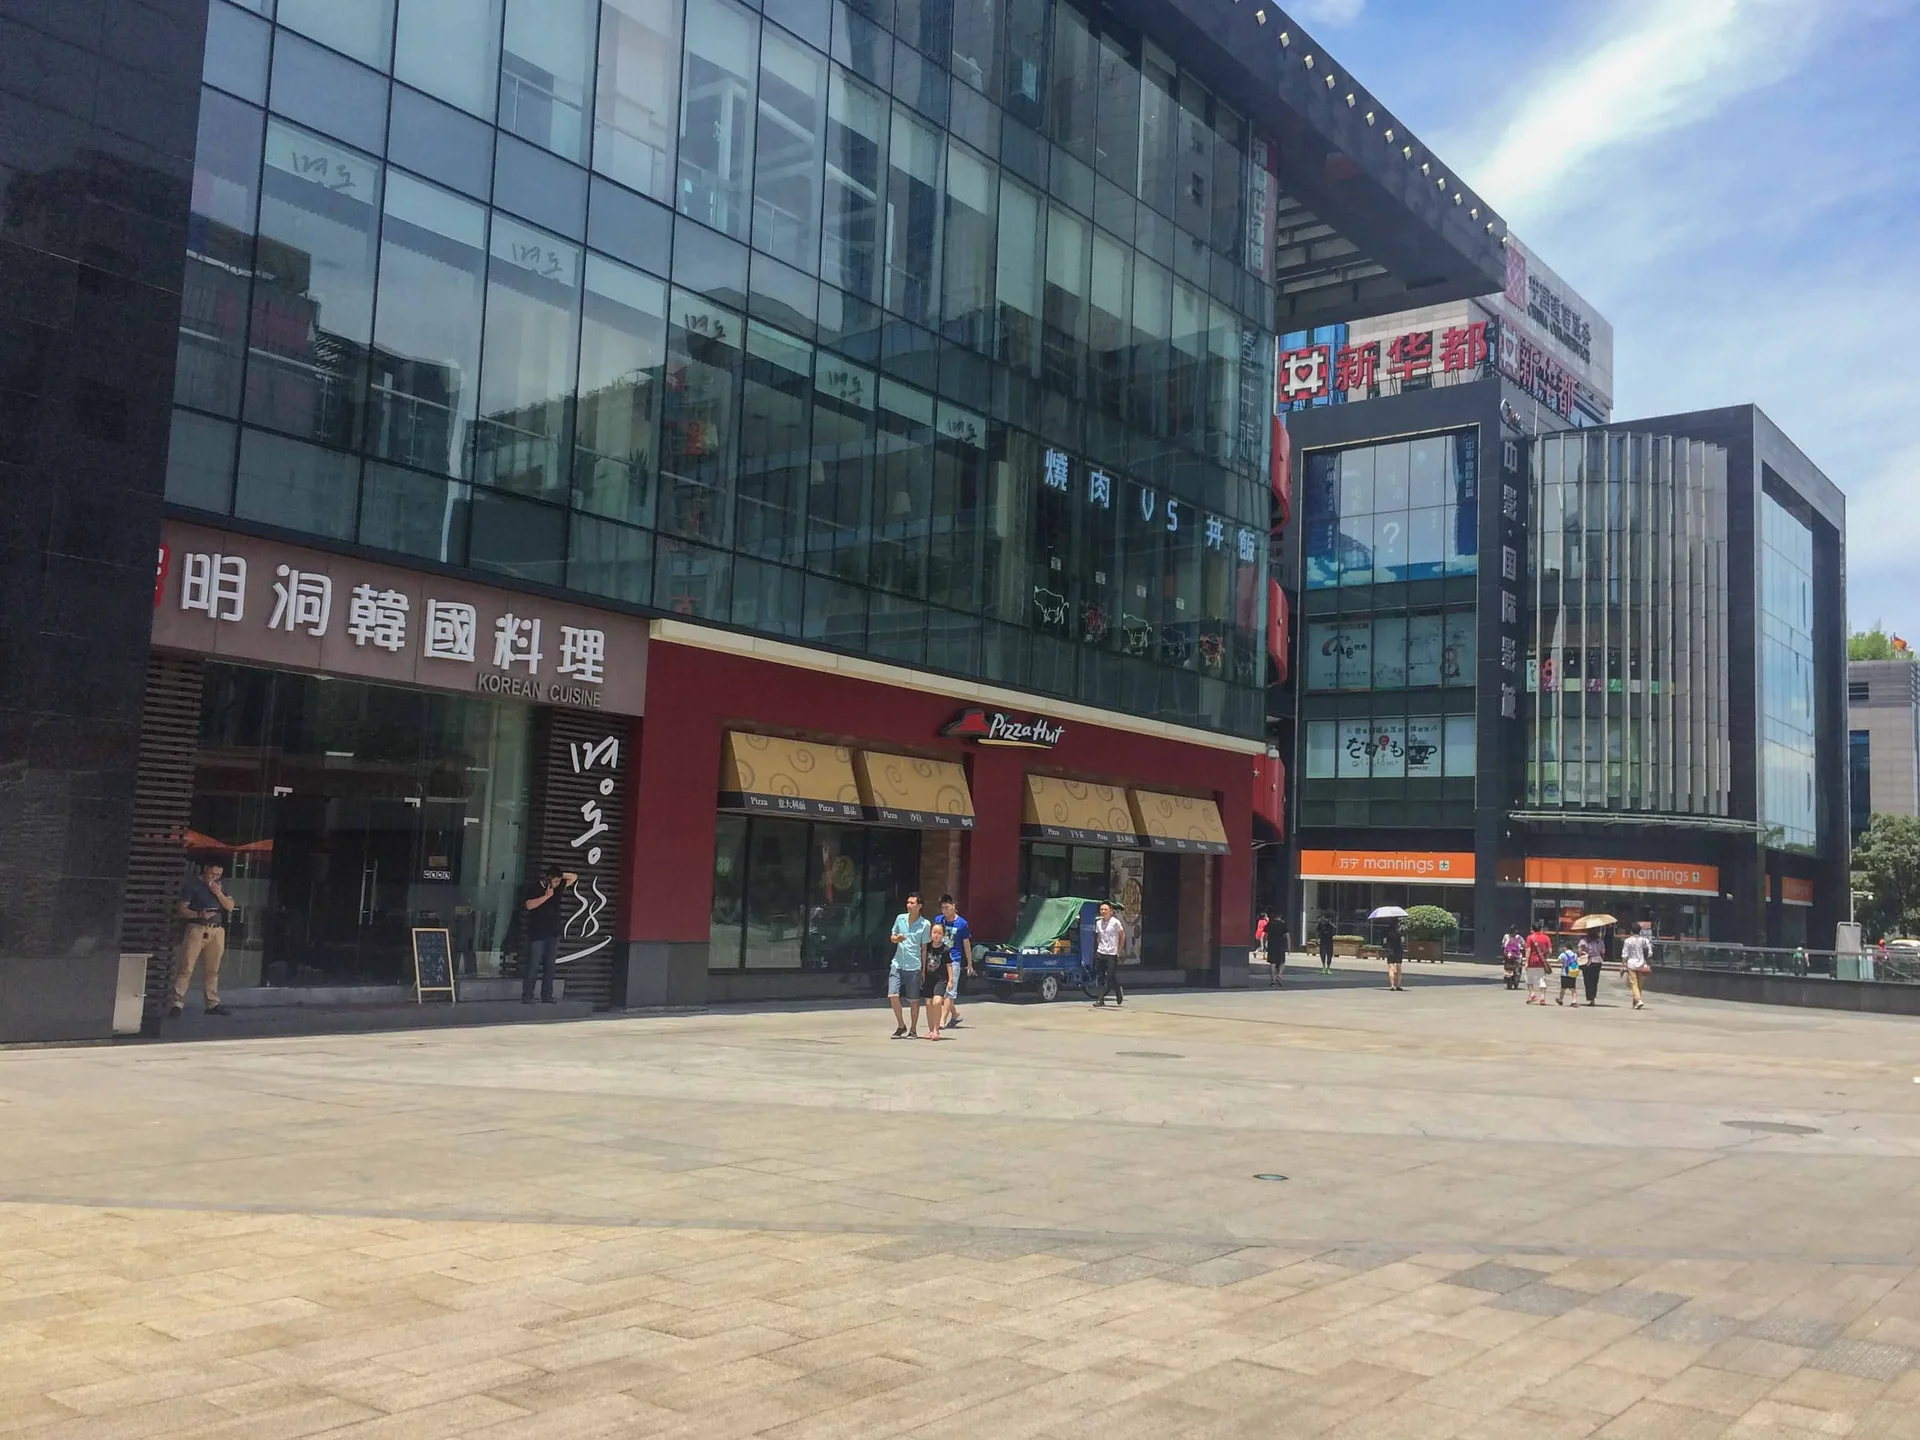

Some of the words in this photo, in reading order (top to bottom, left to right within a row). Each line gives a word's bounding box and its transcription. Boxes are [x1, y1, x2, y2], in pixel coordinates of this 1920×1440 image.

[1335, 320, 1488, 392] 新华都
[1519, 335, 1577, 420] 新华都
[180, 552, 605, 684] 明洞韓國料理
[477, 673, 541, 700] KOREAN
[549, 684, 601, 708] CUISINE
[988, 713, 1032, 741] Pizza
[1030, 719, 1066, 744] Hut
[750, 796, 769, 806] Pizza
[818, 803, 835, 812] Pizza
[882, 810, 899, 819] Pizza
[935, 815, 950, 824] Pizza
[1363, 856, 1435, 874] mannings
[1622, 866, 1690, 885] mannings
